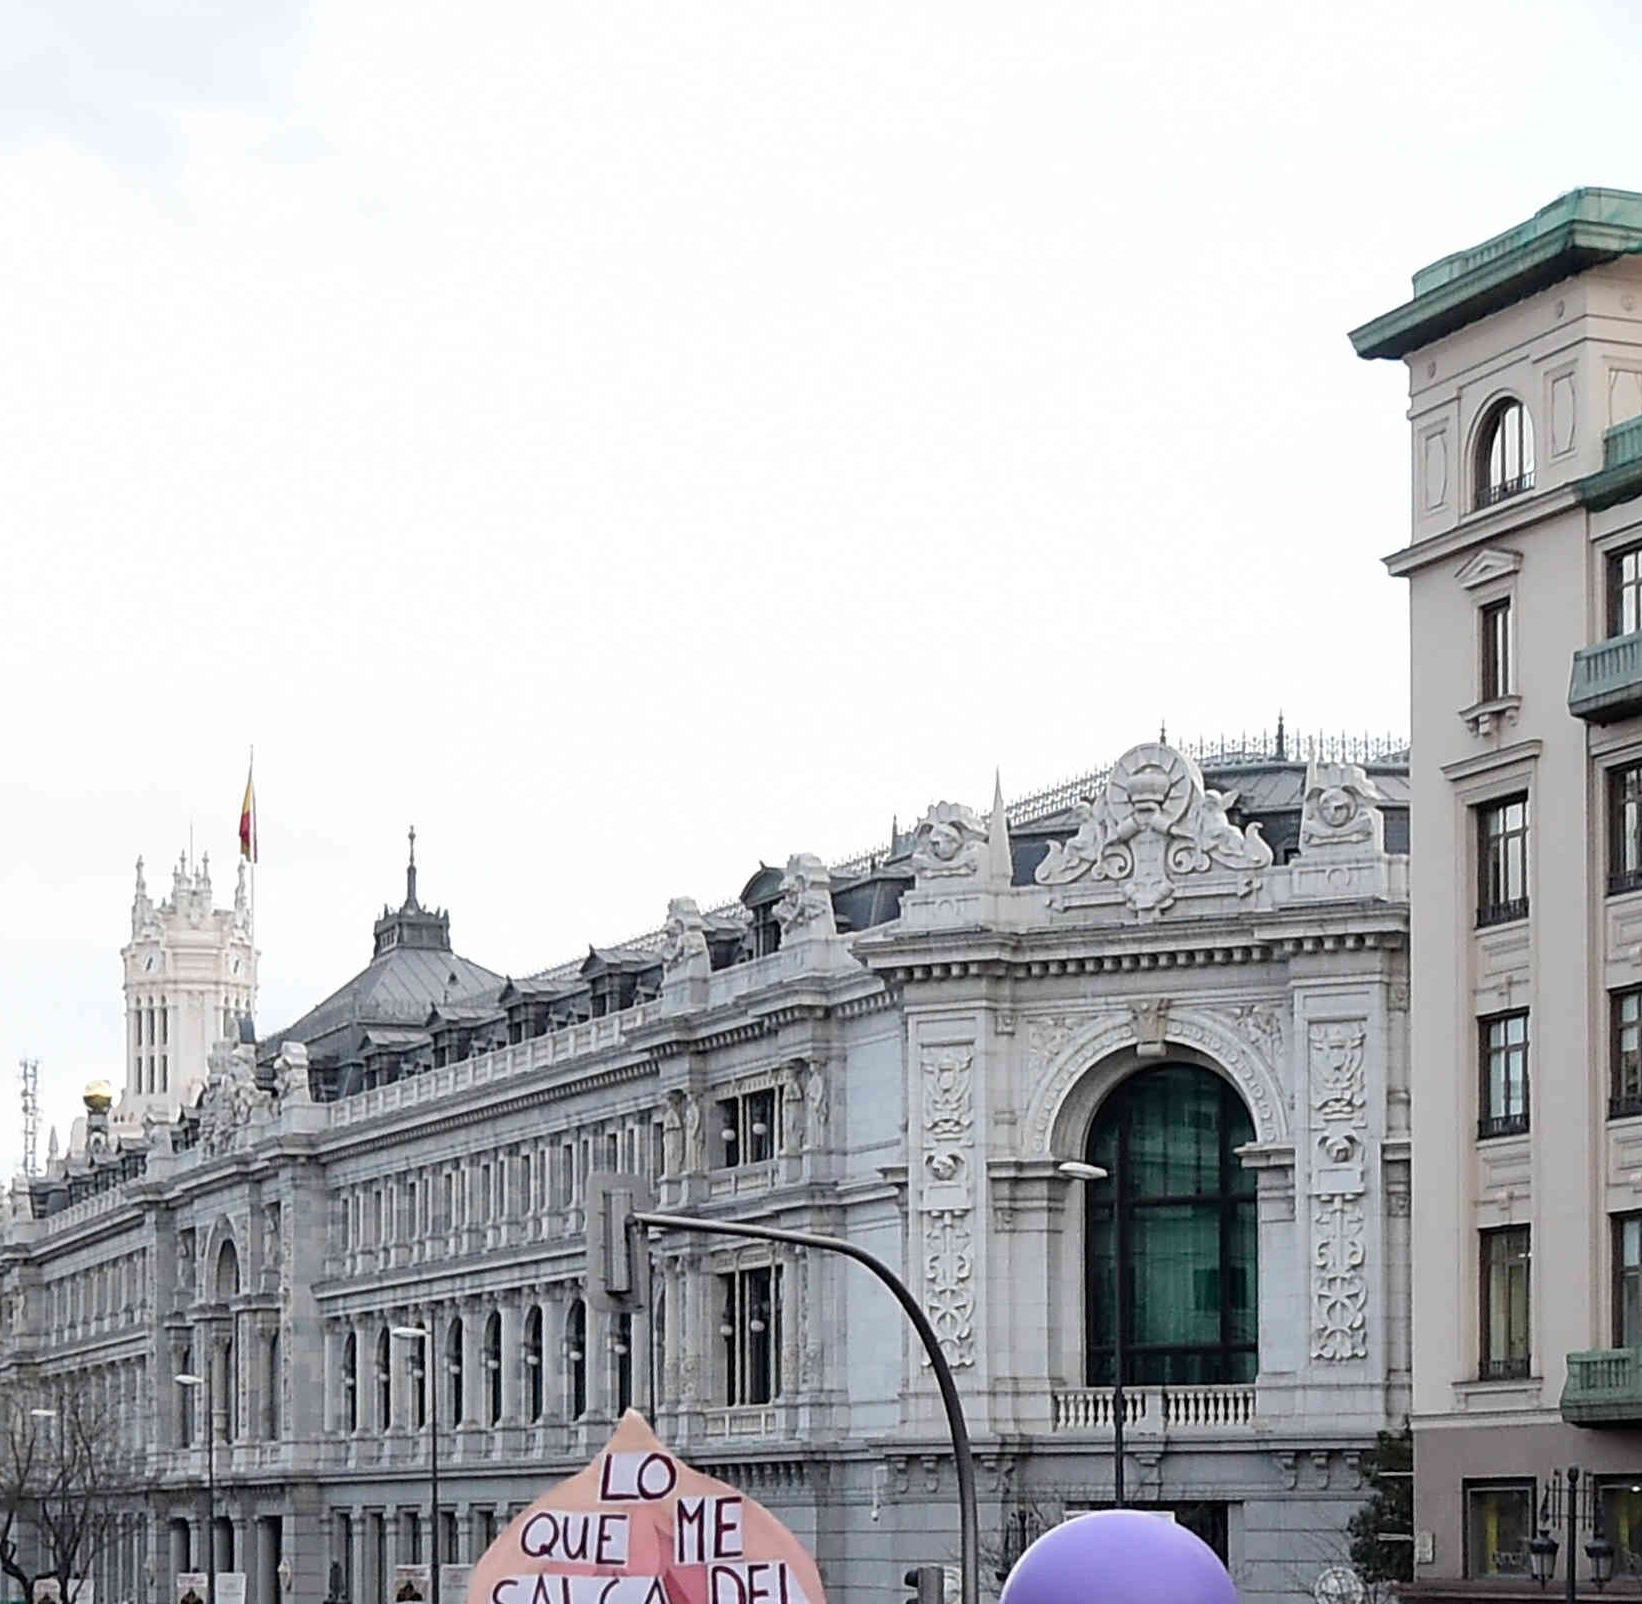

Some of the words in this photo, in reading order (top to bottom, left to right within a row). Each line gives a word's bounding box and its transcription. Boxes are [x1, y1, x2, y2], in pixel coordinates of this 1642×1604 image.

[601, 1453, 676, 1500] LO
[521, 1512, 627, 1565] QUE
[677, 1497, 742, 1563] ME
